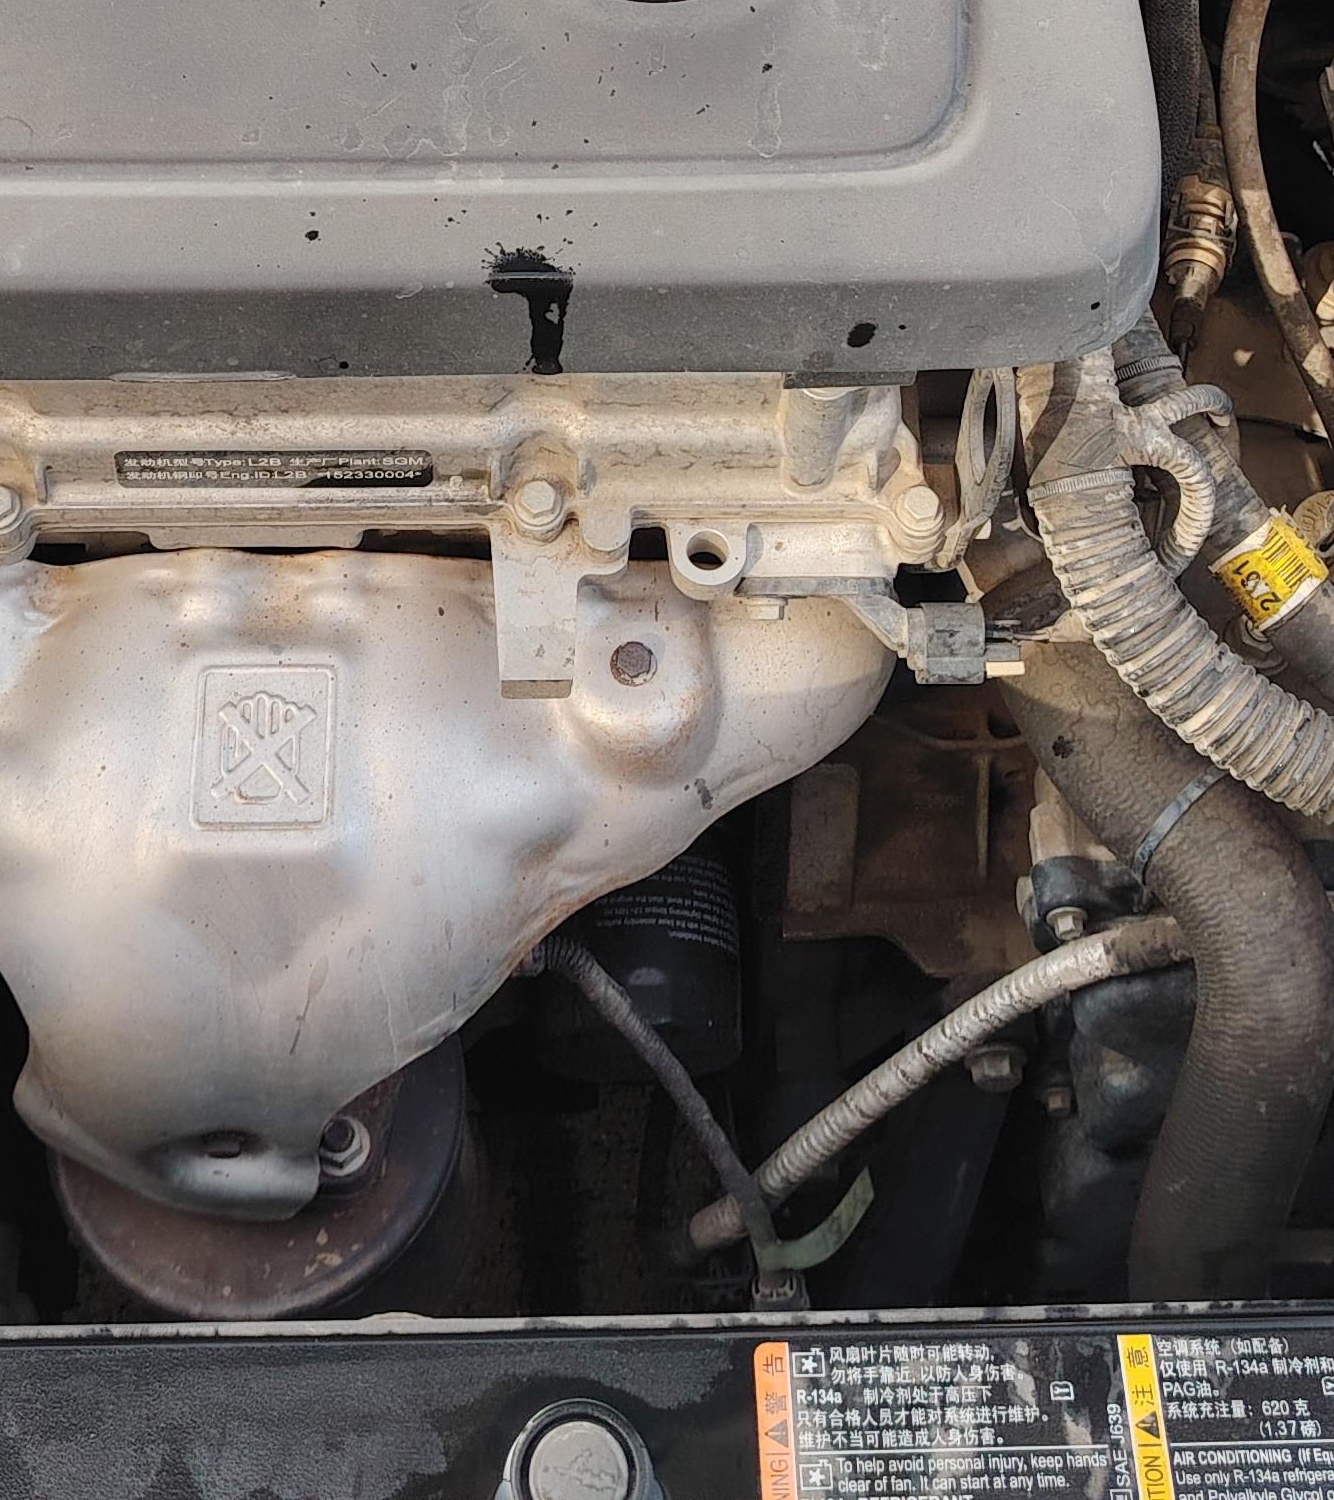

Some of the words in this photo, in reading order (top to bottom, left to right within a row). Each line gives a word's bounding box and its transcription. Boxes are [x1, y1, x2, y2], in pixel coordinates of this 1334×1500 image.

[1127, 1347, 1154, 1406] 注意
[1159, 1359, 1207, 1378] 仅使用
[1215, 1358, 1268, 1376] R-134a
[796, 1388, 843, 1404] R-134a
[863, 1385, 993, 1405] 制冷剂处于高压下
[1261, 1400, 1290, 1417] 620
[1293, 1398, 1311, 1417] 克
[1106, 1403, 1125, 1445] J639
[836, 1457, 852, 1473] To
[857, 1457, 884, 1477] help
[888, 1455, 924, 1472] avoid
[928, 1454, 985, 1476] personal
[988, 1453, 1028, 1473] injury,
[1031, 1452, 1064, 1471] keep
[1066, 1451, 1108, 1468] hands
[1173, 1451, 1196, 1466] AIR
[1198, 1449, 1292, 1466] CONDITIONING
[1298, 1448, 1313, 1467] (If
[1113, 1449, 1130, 1487] SAE
[1175, 1471, 1202, 1485] Use
[1204, 1469, 1231, 1487] only
[1233, 1469, 1280, 1484] R-134a
[838, 1477, 872, 1493] clear
[874, 1476, 888, 1491] of
[890, 1476, 917, 1492] fan.
[920, 1475, 929, 1491] It
[931, 1477, 956, 1491] can
[960, 1474, 990, 1490] start
[993, 1474, 1005, 1489] at
[1009, 1475, 1034, 1492] any
[1037, 1472, 1071, 1488] time.
